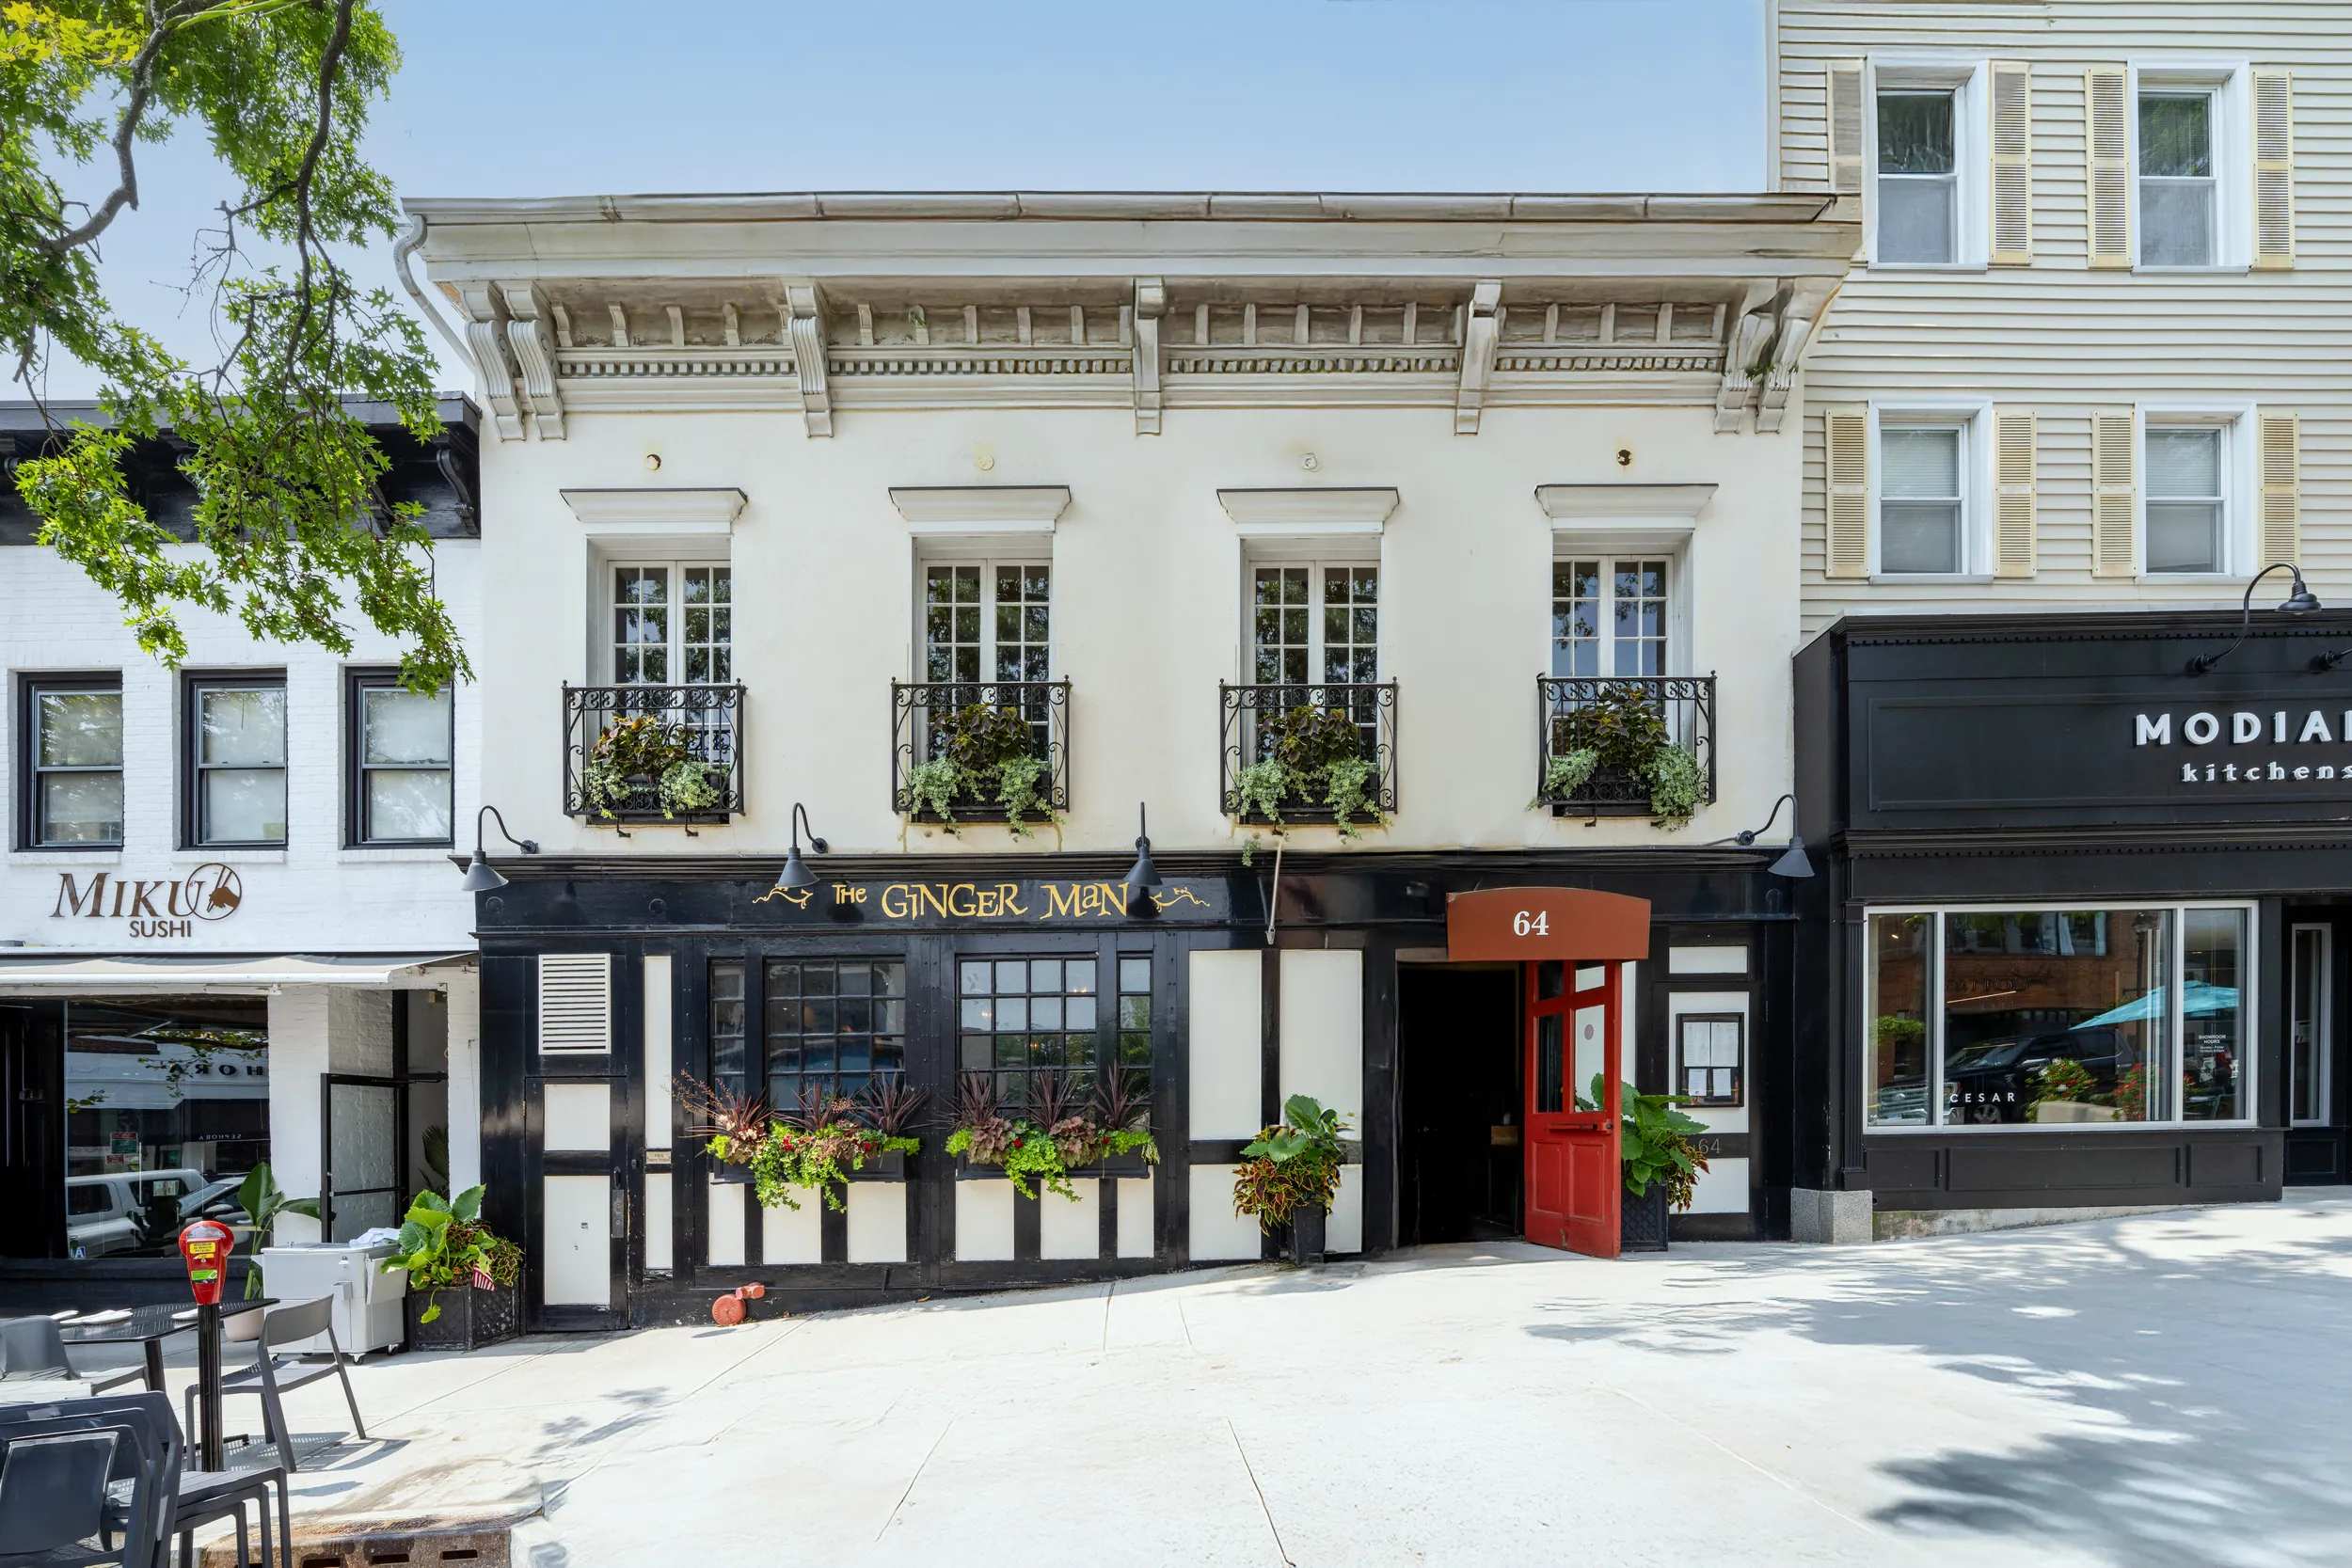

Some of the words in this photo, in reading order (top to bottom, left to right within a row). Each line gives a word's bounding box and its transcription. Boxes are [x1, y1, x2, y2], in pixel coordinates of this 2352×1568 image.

[2136, 710, 2352, 746] MODIA
[2182, 761, 2352, 783] kitchens
[49, 872, 206, 918] MIKU
[129, 920, 192, 938] SUSHI
[1513, 911, 1549, 936] 64
[1949, 1092, 2015, 1103] CESAR
[1698, 1138, 1721, 1154] 64
[74, 1247, 85, 1259] A
